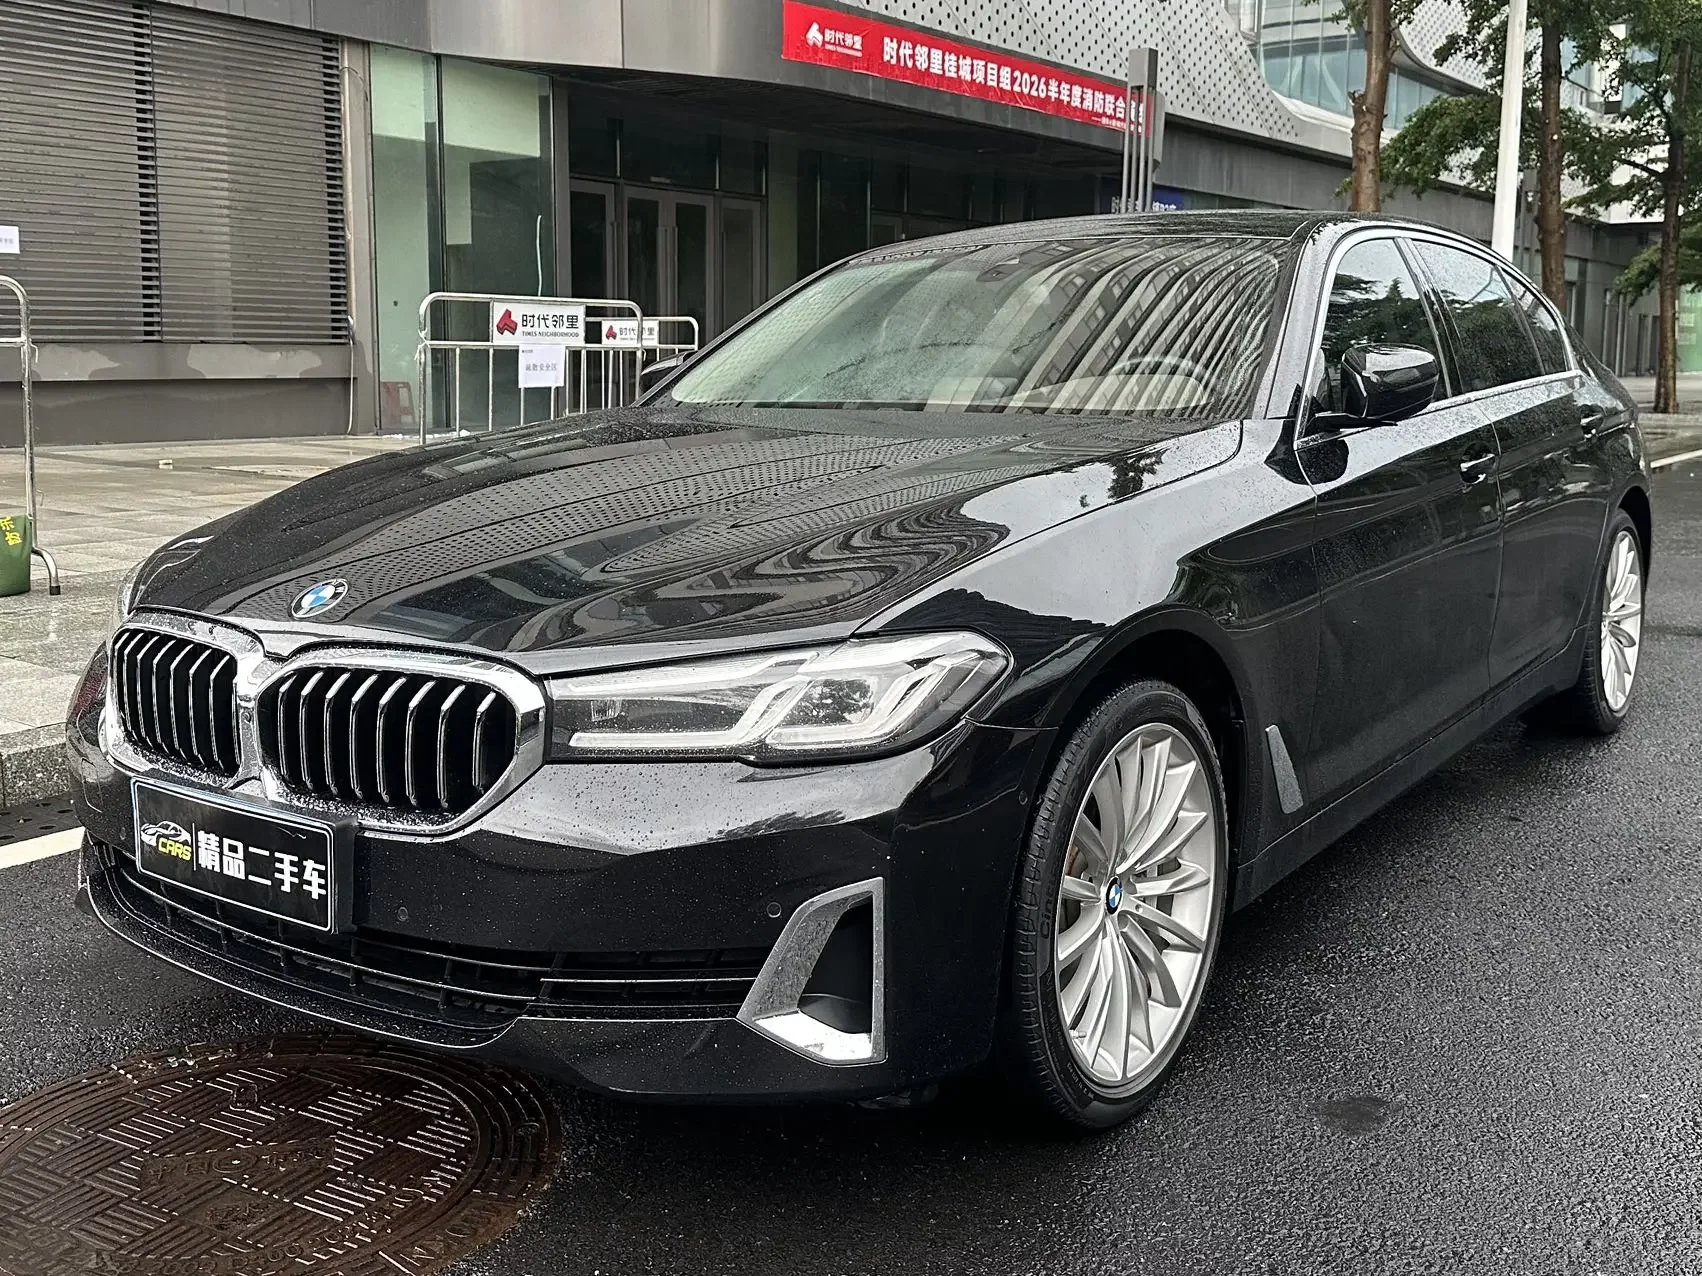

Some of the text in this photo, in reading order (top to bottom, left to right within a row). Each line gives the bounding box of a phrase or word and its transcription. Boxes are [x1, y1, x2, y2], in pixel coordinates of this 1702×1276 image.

[521, 313, 579, 329] 时代邻里
[619, 327, 655, 336] 时代里
[158, 837, 192, 861] CARS
[197, 830, 327, 900] 精品二手车
